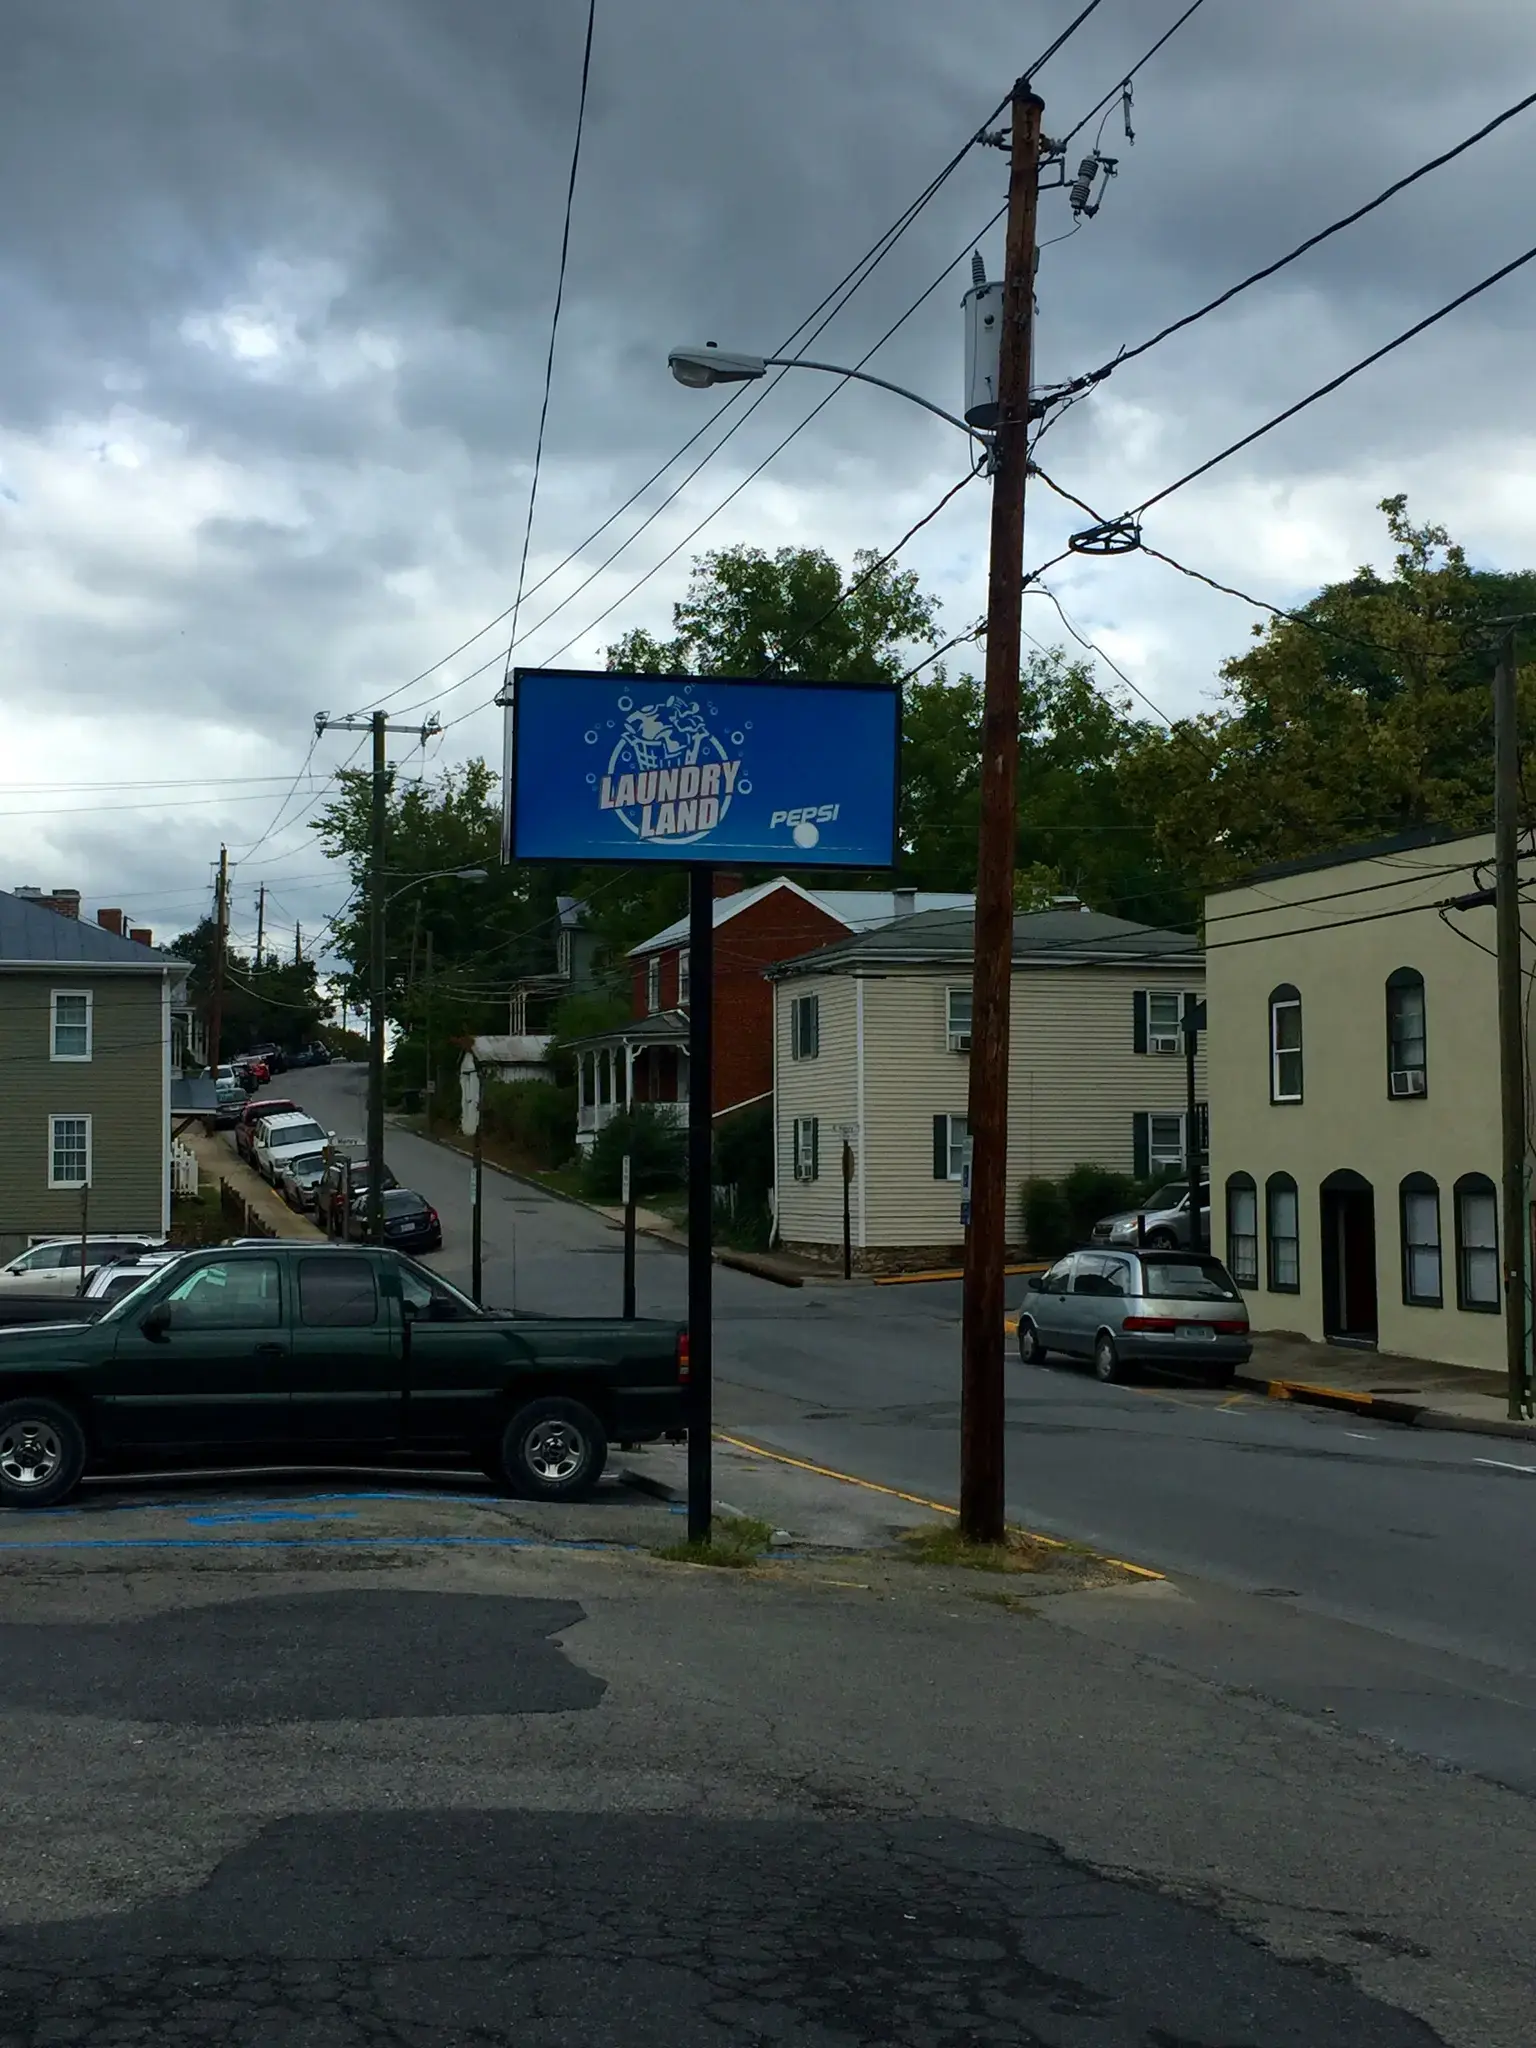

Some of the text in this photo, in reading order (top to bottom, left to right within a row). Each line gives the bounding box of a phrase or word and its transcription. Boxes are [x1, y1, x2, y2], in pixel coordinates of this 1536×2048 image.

[599, 760, 741, 810] LAUNDRY
[639, 797, 720, 839] LAND
[769, 803, 841, 829] PEPSI
